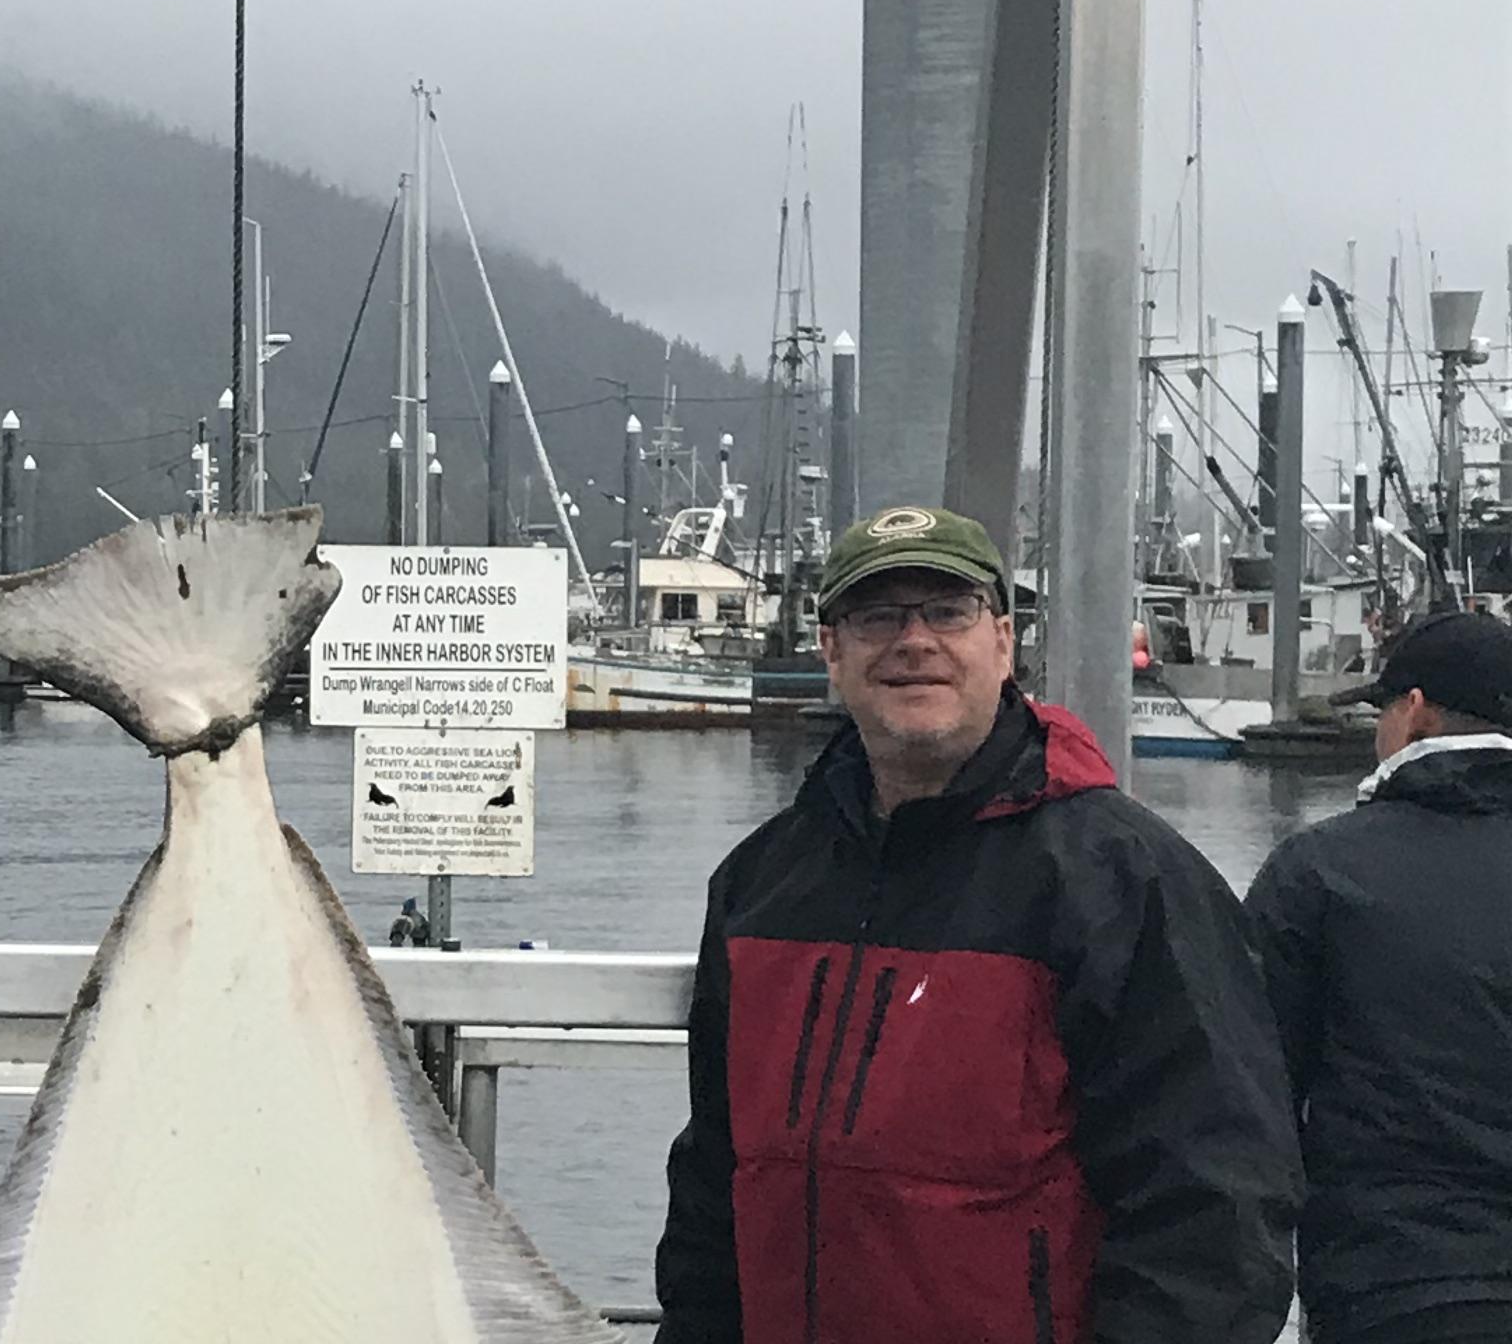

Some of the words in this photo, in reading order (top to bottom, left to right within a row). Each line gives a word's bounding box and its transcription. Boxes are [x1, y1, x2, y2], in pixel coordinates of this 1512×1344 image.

[391, 557, 412, 575] NO
[417, 557, 488, 576] DUMPING
[362, 585, 382, 603] OF
[387, 585, 419, 604] FISH
[424, 586, 517, 605] CARCASSES
[392, 614, 411, 633] AT
[415, 614, 446, 633] ANY
[450, 615, 485, 633] TIME
[323, 643, 337, 661] IN
[342, 643, 371, 661] THE
[376, 643, 423, 662] INNER
[427, 644, 491, 663] HARBOR
[496, 644, 555, 663] SYSTEM
[323, 676, 357, 695] Dump
[360, 676, 412, 695] Wrangell
[416, 677, 464, 692] Narrows
[469, 677, 492, 692] side
[497, 677, 509, 692] of
[513, 677, 522, 692] C
[525, 677, 554, 693] Float
[363, 700, 420, 718] Municipal
[365, 746, 386, 755] DUE
[391, 746, 404, 756] TO
[406, 746, 469, 757] AGGRESSIVE
[473, 747, 493, 757] SEA
[413, 759, 432, 768] ALL
[435, 759, 457, 768] FISH
[460, 759, 520, 770] CARCASSE
[374, 771, 402, 780] NEED
[405, 771, 418, 780] TO
[421, 771, 434, 780] BE
[436, 772, 480, 781] DUMPED
[399, 783, 428, 793] FROM
[431, 784, 453, 793] THIS
[363, 812, 400, 823] FAILURE
[404, 813, 415, 822] TO
[416, 813, 452, 823] COMPLY
[373, 825, 389, 834] THE
[451, 826, 471, 836] THIS
